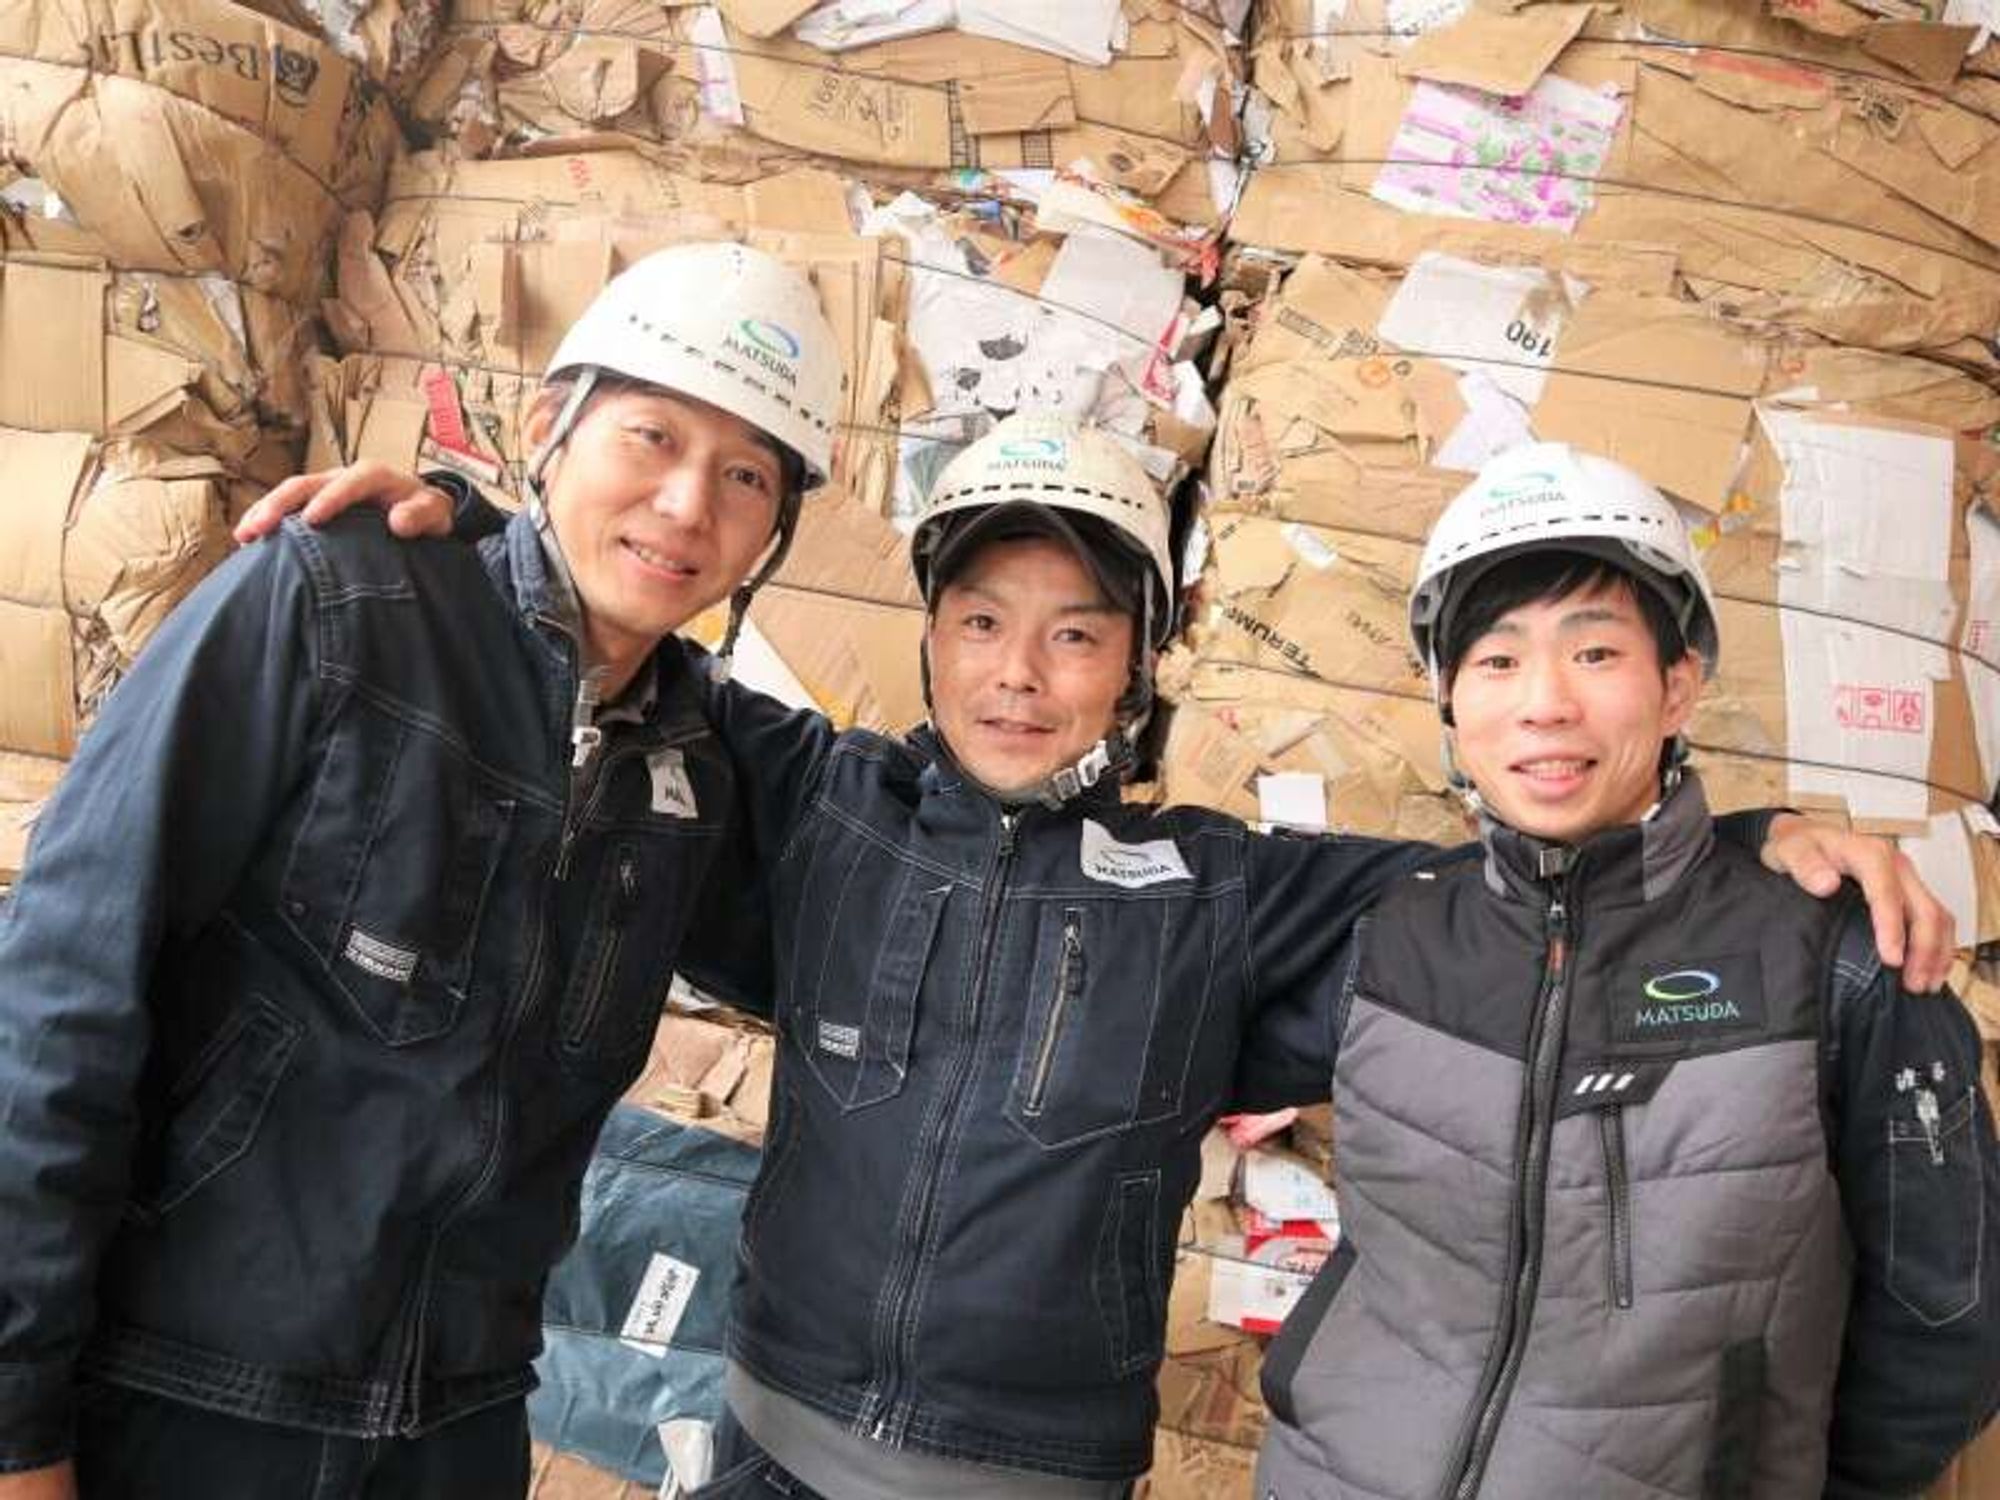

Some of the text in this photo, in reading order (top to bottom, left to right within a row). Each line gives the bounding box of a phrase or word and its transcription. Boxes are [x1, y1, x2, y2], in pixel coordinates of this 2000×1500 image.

[722, 336, 797, 390] MATSUDA
[1095, 863, 1173, 880] MATSUDA
[1636, 999, 1741, 1027] MATSUDA
